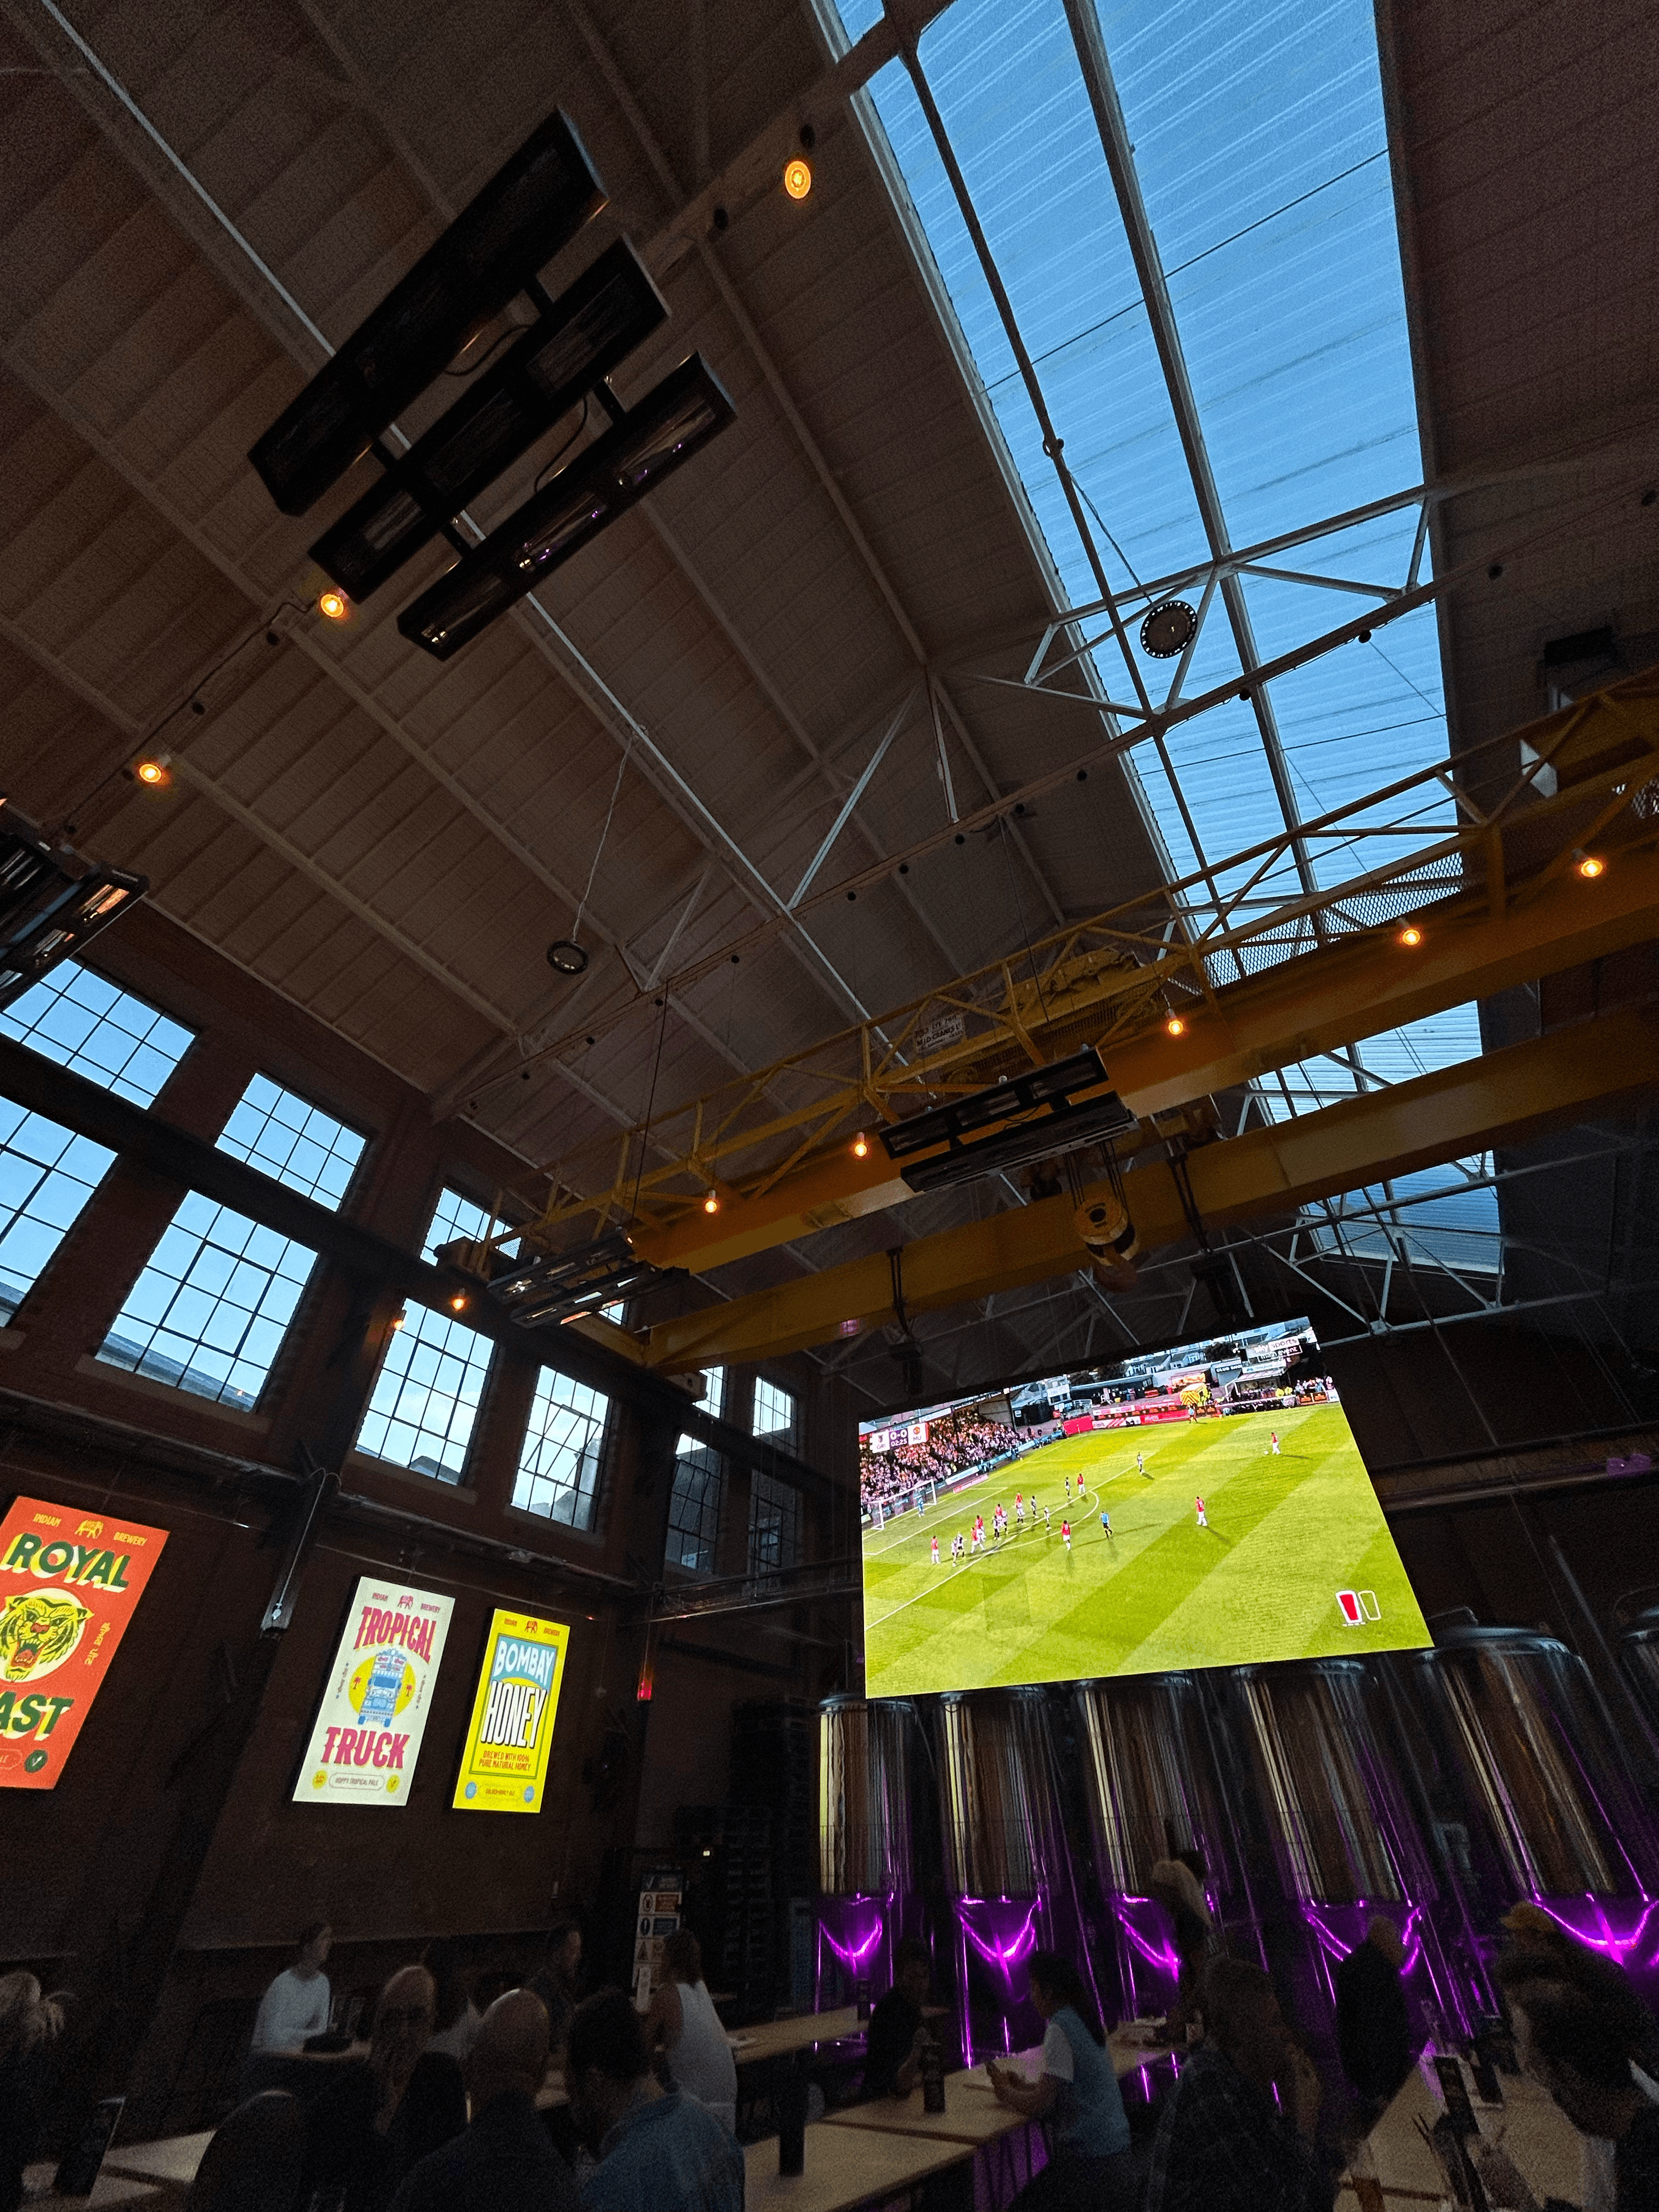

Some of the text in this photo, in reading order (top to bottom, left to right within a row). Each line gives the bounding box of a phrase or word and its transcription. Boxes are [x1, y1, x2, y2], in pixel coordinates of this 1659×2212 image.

[1271, 1339, 1297, 1348] sports
[1278, 1346, 1298, 1356] event
[890, 1429, 907, 1440] 0-0
[891, 1438, 907, 1447] 02:25
[33, 1513, 148, 1546] INDIAN BREWERY
[1, 1532, 131, 1593] ROYAL
[372, 1592, 441, 1613] INDIAN BREWERY
[353, 1606, 437, 1664] TROPICAL
[493, 1640, 555, 1687] BOMBAY
[0, 1691, 75, 1741] AST
[481, 1680, 548, 1750] HONEY
[320, 1726, 410, 1769] TRUCK
[483, 1750, 529, 1763] BREWED WITH 100%
[479, 1758, 532, 1771] PURE NATURAL HONEY
[349, 1778, 368, 1786] TROPICAL
